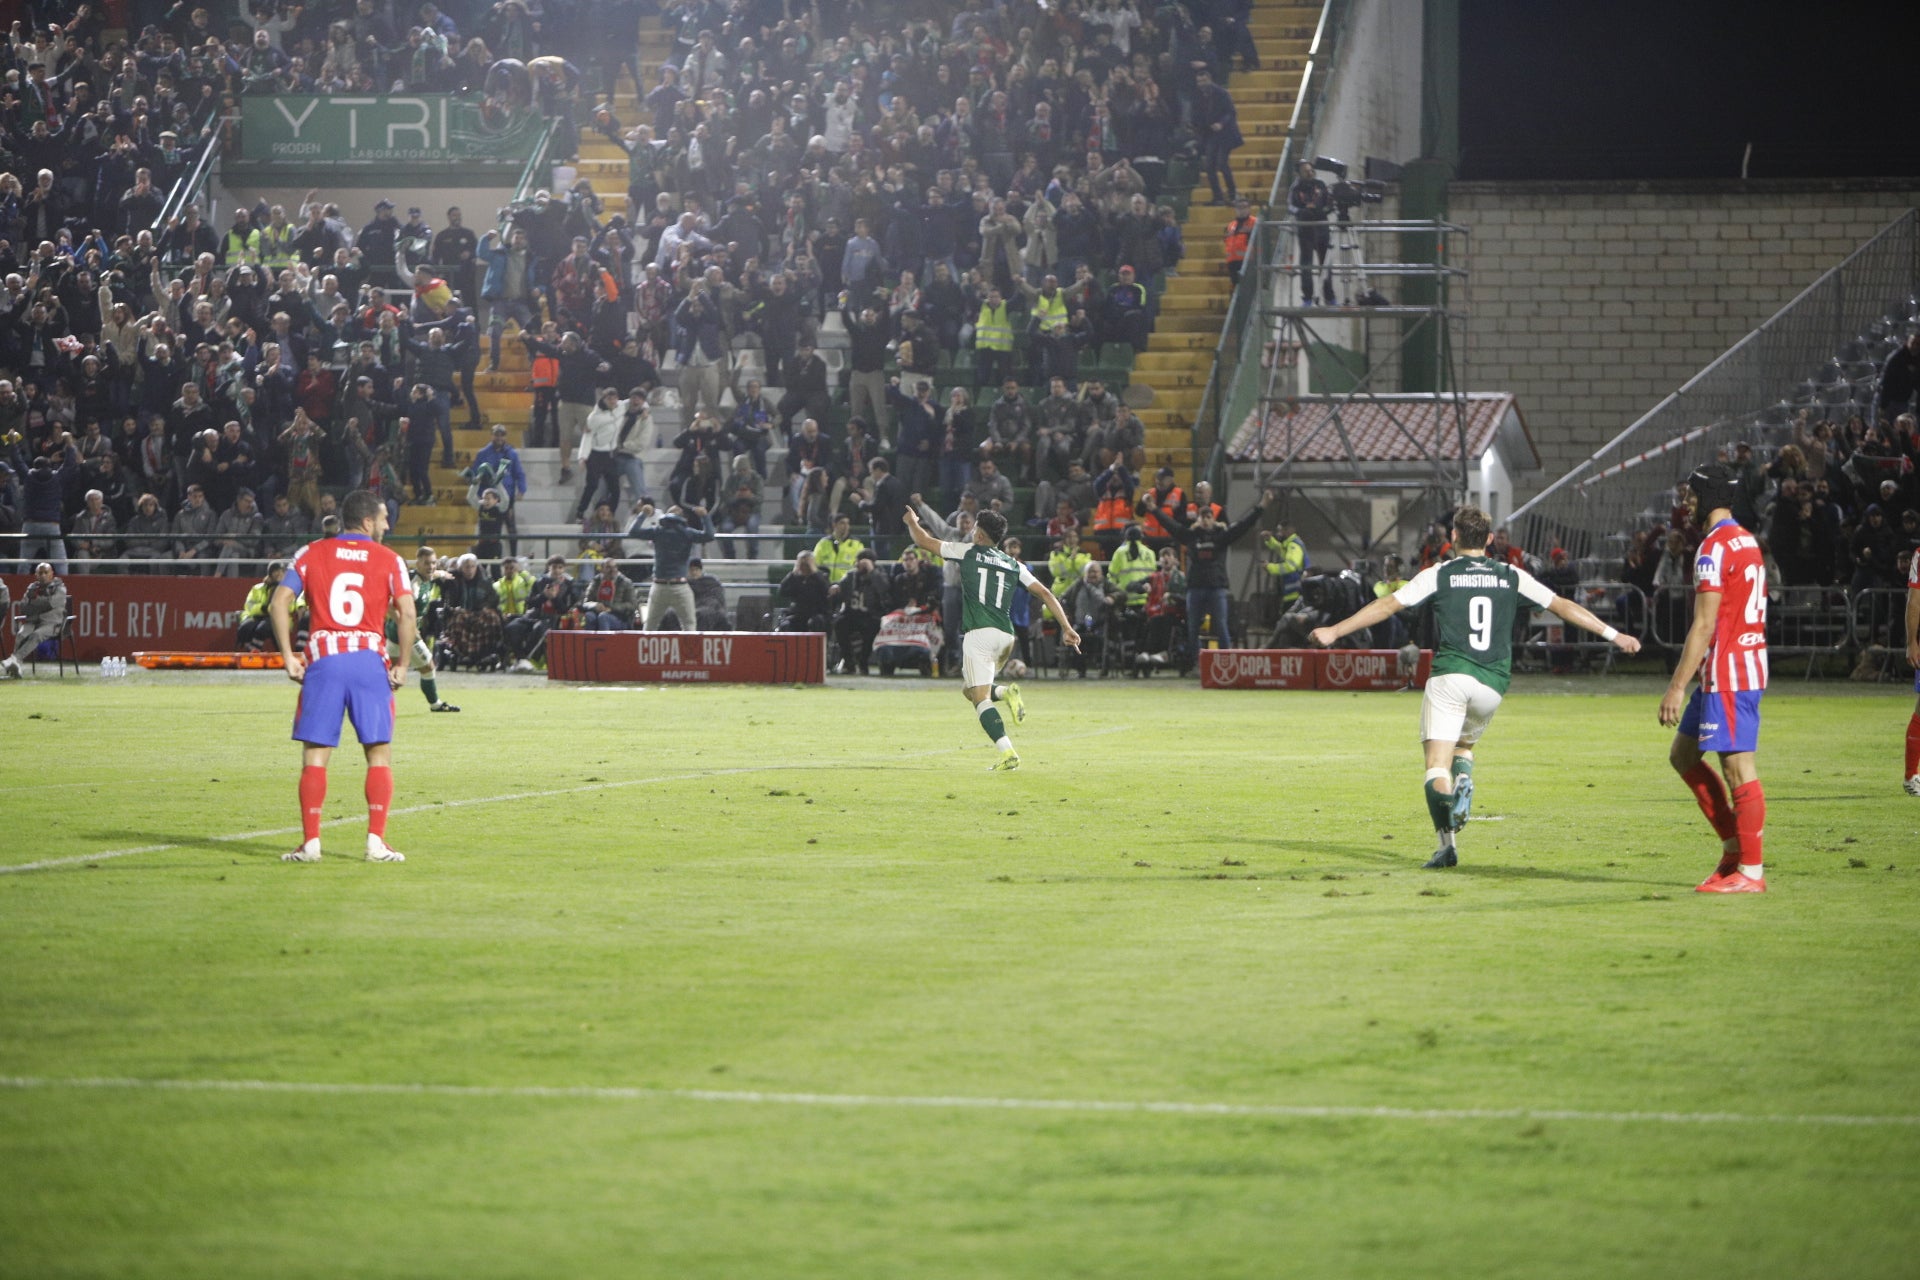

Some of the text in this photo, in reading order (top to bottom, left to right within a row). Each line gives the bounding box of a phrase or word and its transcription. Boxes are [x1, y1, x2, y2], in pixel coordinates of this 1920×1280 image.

[272, 142, 321, 154] PRODEN
[351, 150, 440, 159] LABORATORIO
[336, 547, 369, 562] KOKE
[977, 567, 1005, 608] 11
[1450, 574, 1498, 588] CHRISTIAN
[329, 572, 364, 627] 6
[80, 602, 238, 637] DEL REY MAP
[1469, 596, 1492, 651] 9
[638, 636, 680, 664] COPA
[703, 638, 732, 665] REY
[661, 670, 709, 680] MAPFRE
[1240, 655, 1303, 676] COPA REY
[1355, 656, 1386, 677] COPA
